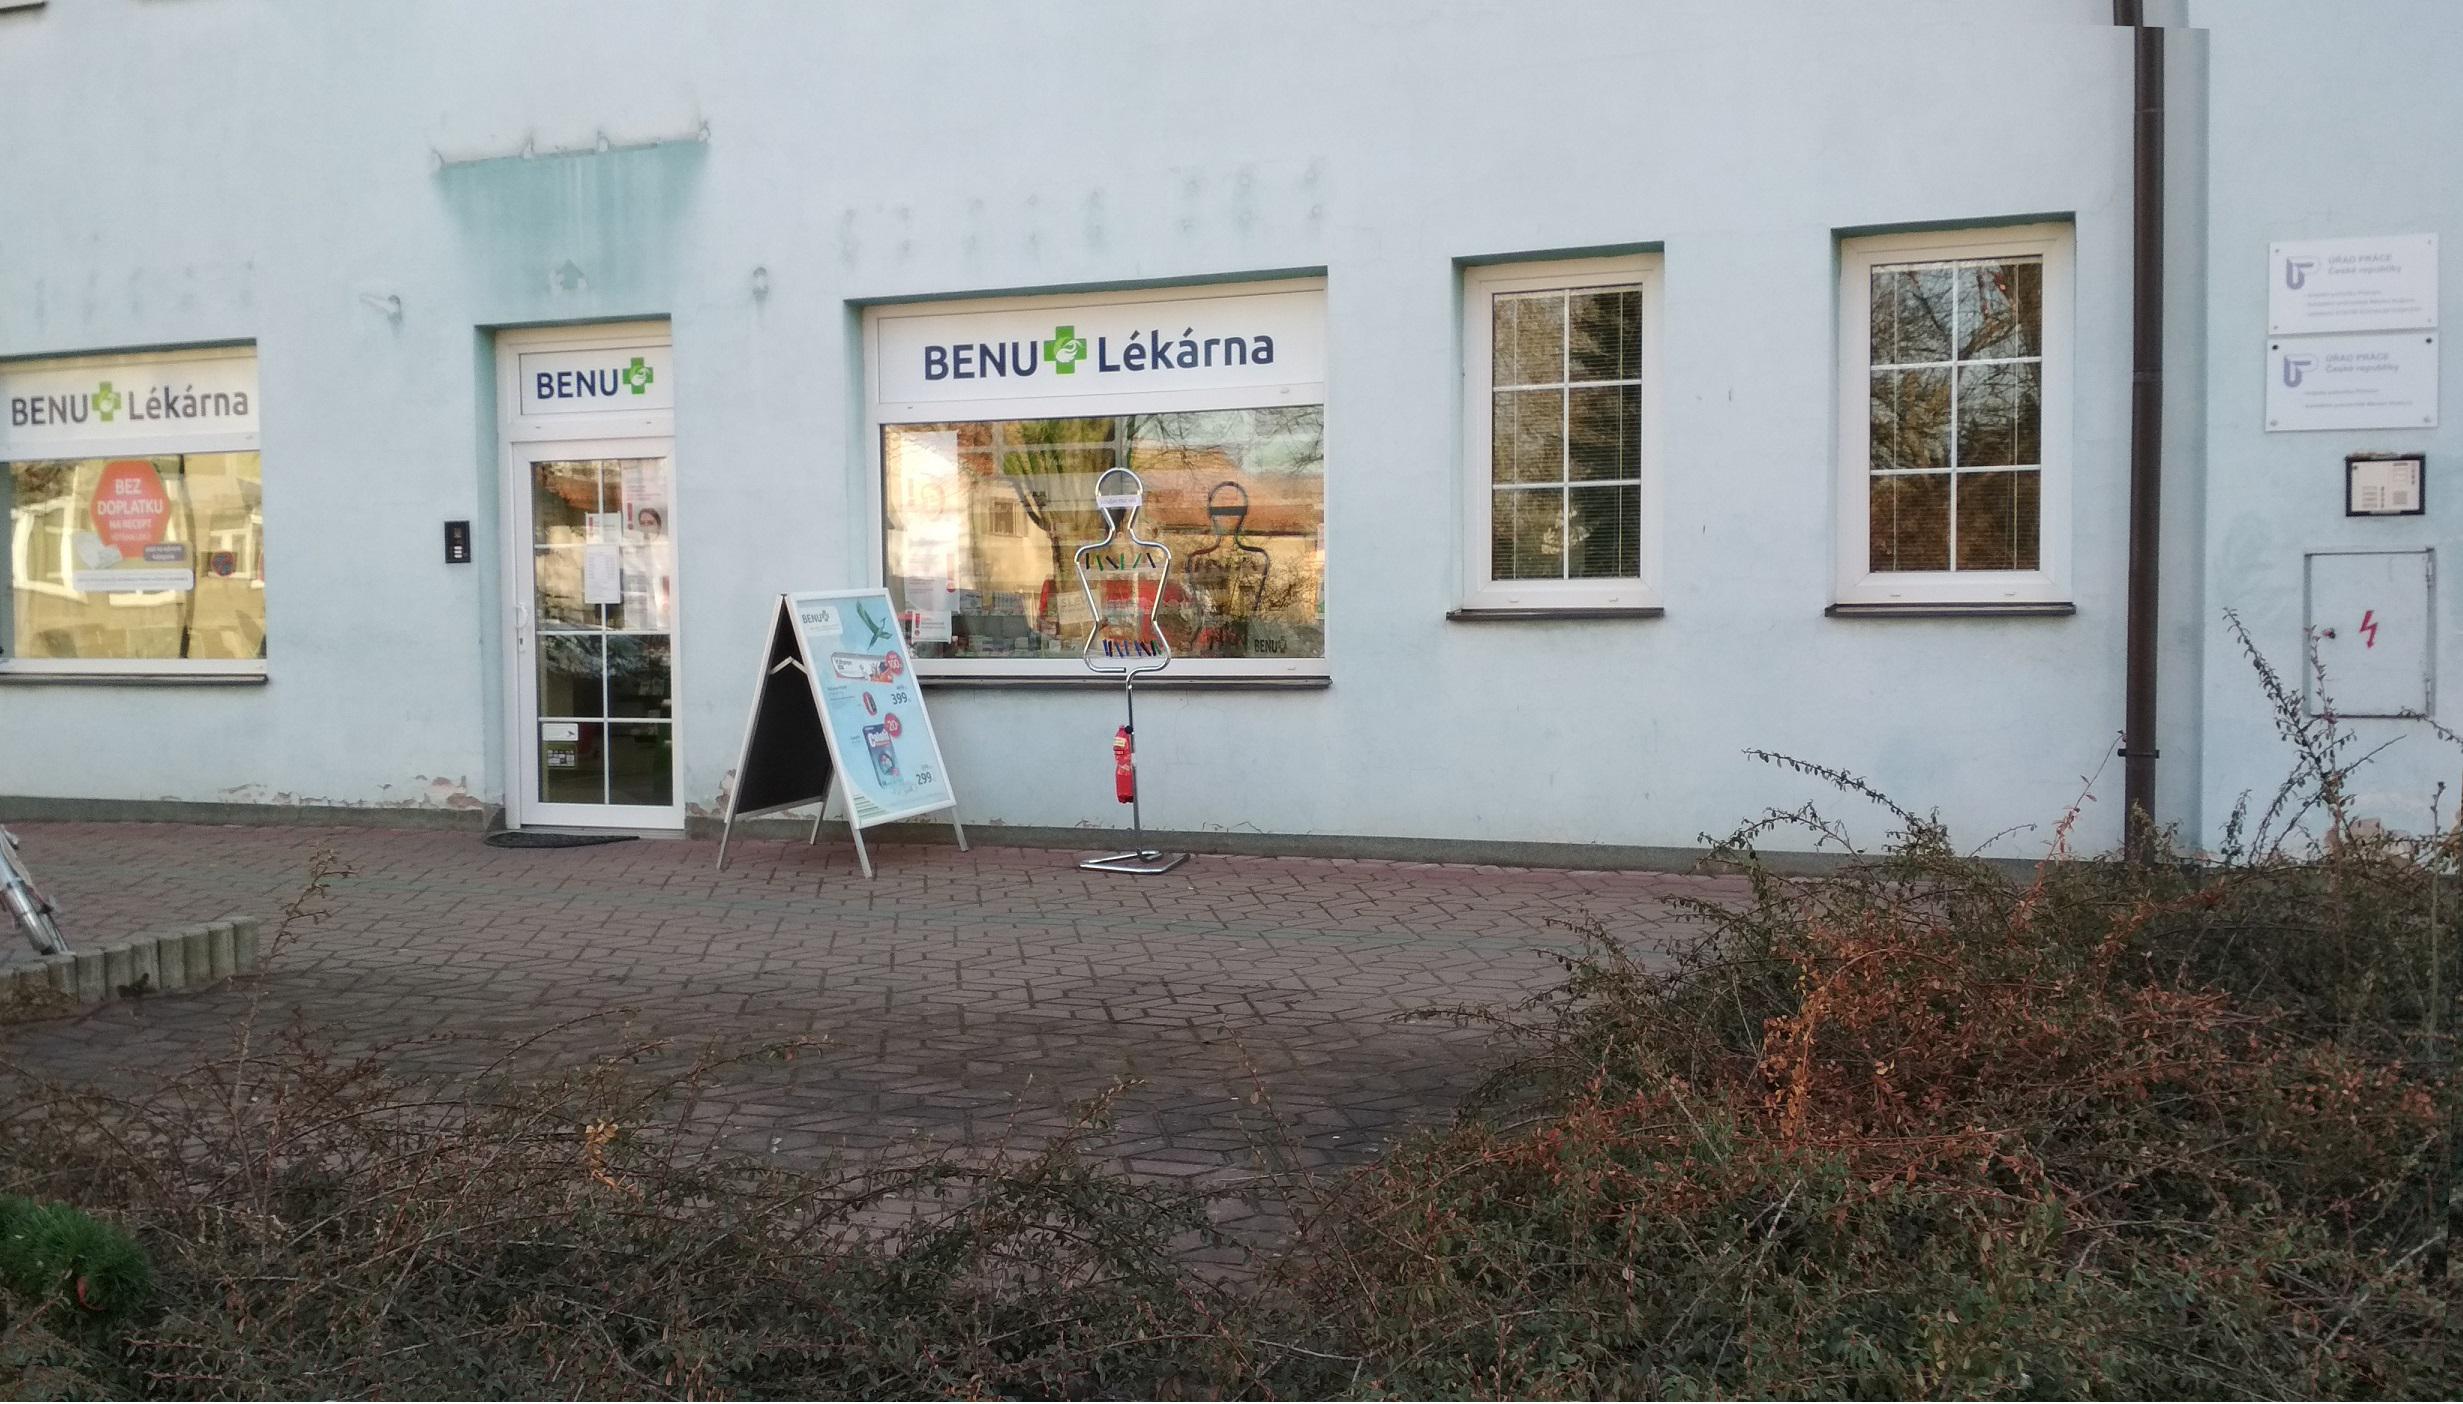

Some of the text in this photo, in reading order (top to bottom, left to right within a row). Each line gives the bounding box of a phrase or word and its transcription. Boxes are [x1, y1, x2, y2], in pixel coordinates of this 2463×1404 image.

[924, 326, 1275, 381] BENU Lékárna
[536, 368, 619, 400] BENU
[11, 384, 249, 427] BENU Lékárna
[115, 478, 142, 496] BEZ
[96, 498, 164, 516] DOPLATKU
[801, 613, 823, 624] BENU
[1254, 638, 1278, 653] BENU
[890, 692, 908, 706] 399
[915, 771, 933, 786] 299
